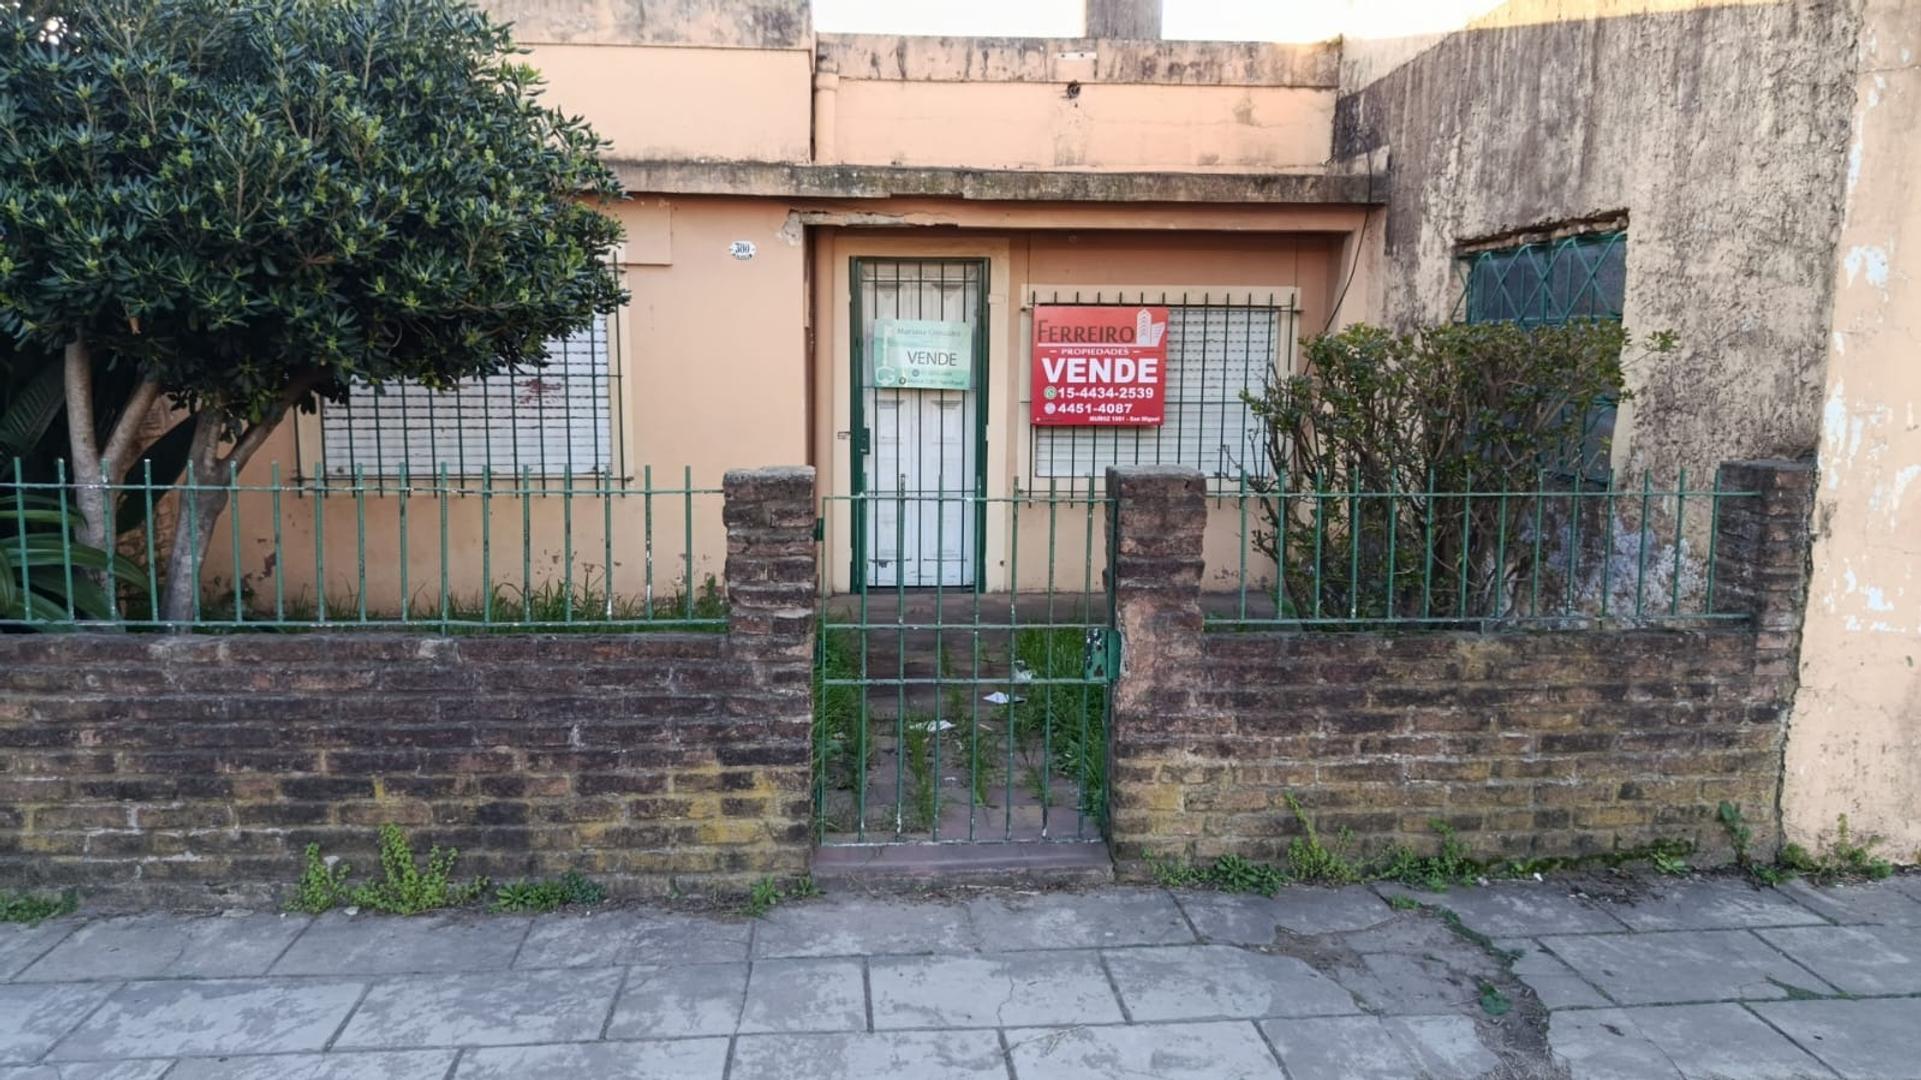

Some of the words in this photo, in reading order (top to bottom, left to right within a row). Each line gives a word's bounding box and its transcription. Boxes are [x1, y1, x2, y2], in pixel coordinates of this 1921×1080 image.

[1038, 319, 1136, 343] FERREIRO
[907, 351, 957, 366] VENDE
[1041, 358, 1158, 383] VENDE
[1058, 387, 1154, 398] 15-4434-2539
[1057, 404, 1133, 413] 4451-4087
